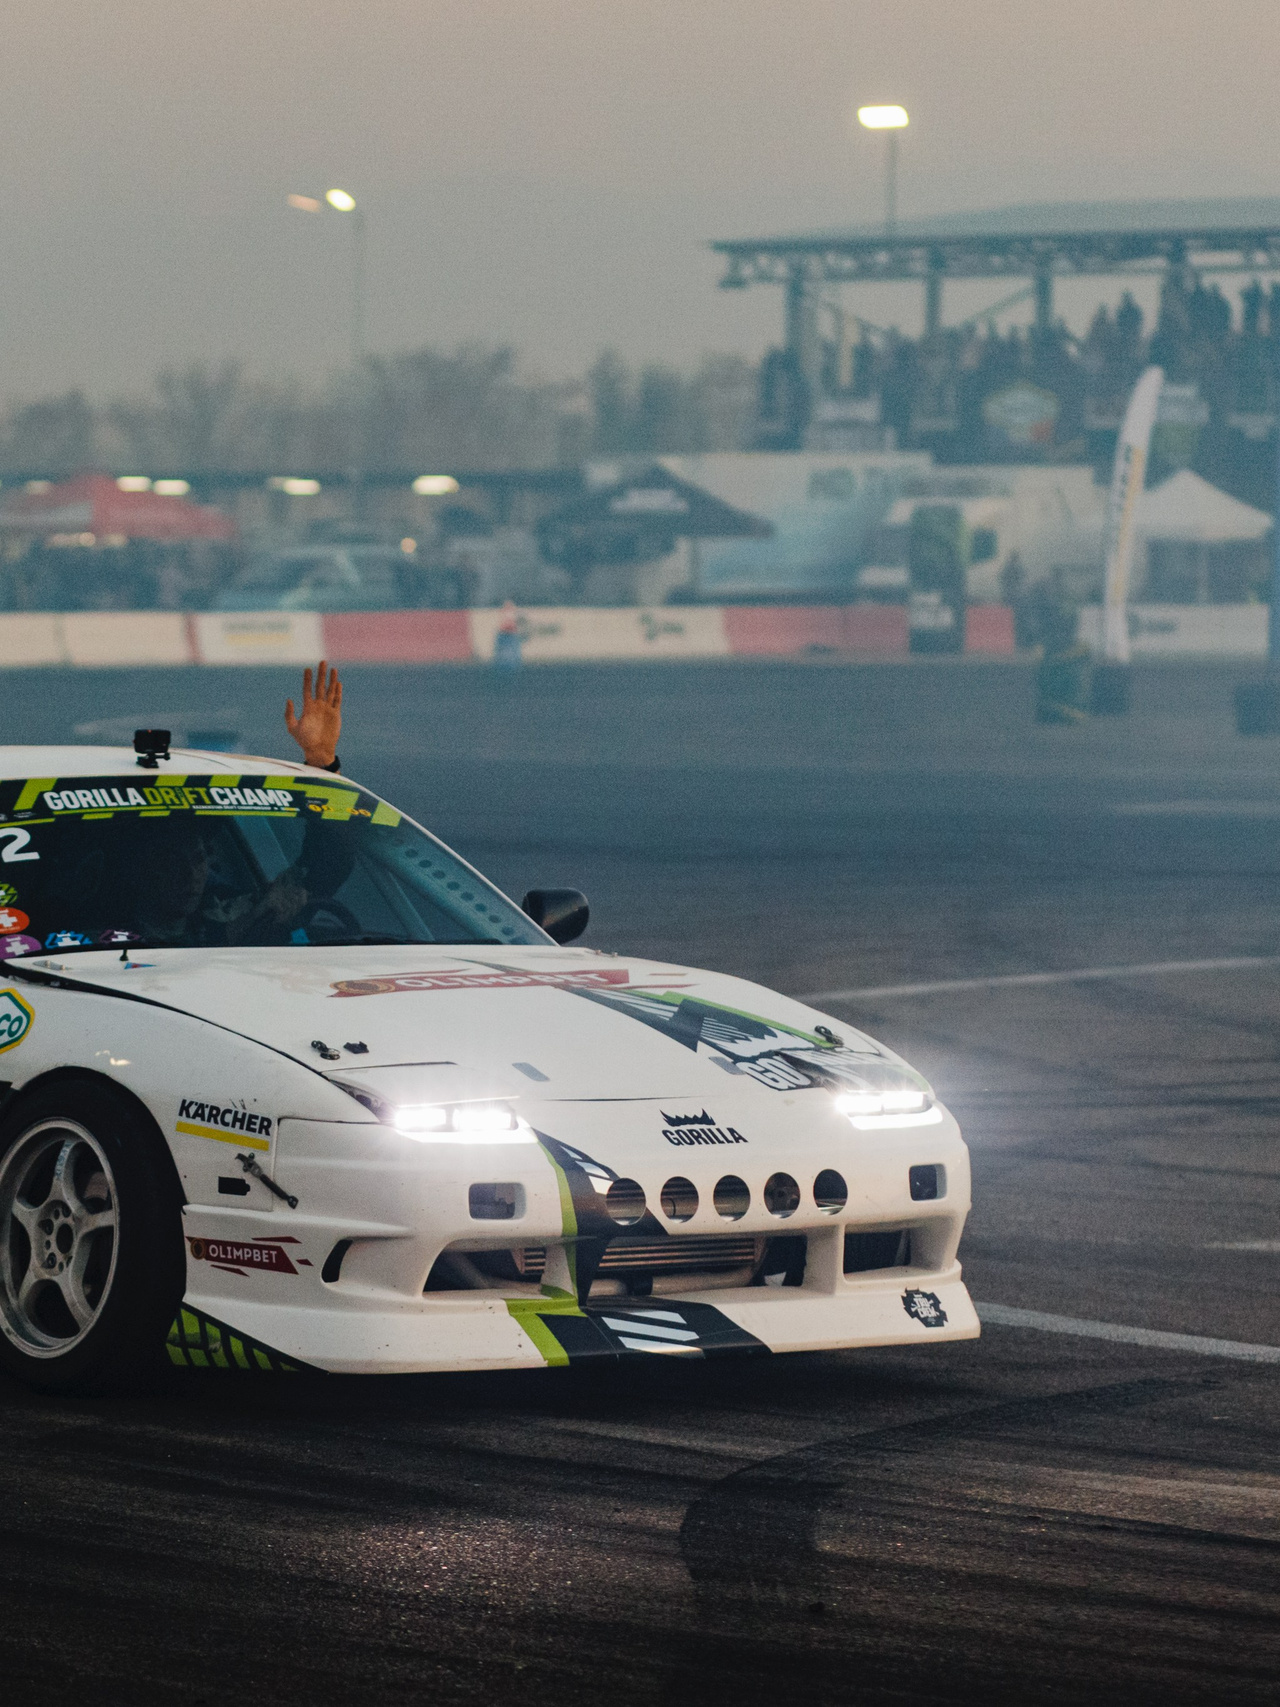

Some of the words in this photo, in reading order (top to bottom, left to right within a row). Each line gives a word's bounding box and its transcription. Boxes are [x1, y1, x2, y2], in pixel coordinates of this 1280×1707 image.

[43, 787, 147, 811] GORILLA
[209, 787, 294, 807] CHAMP
[395, 973, 610, 988] OLIMPBET
[178, 1099, 272, 1136] KÄRCHER
[661, 1127, 749, 1146] GORILLA
[208, 1244, 277, 1263] OLIMPBET
